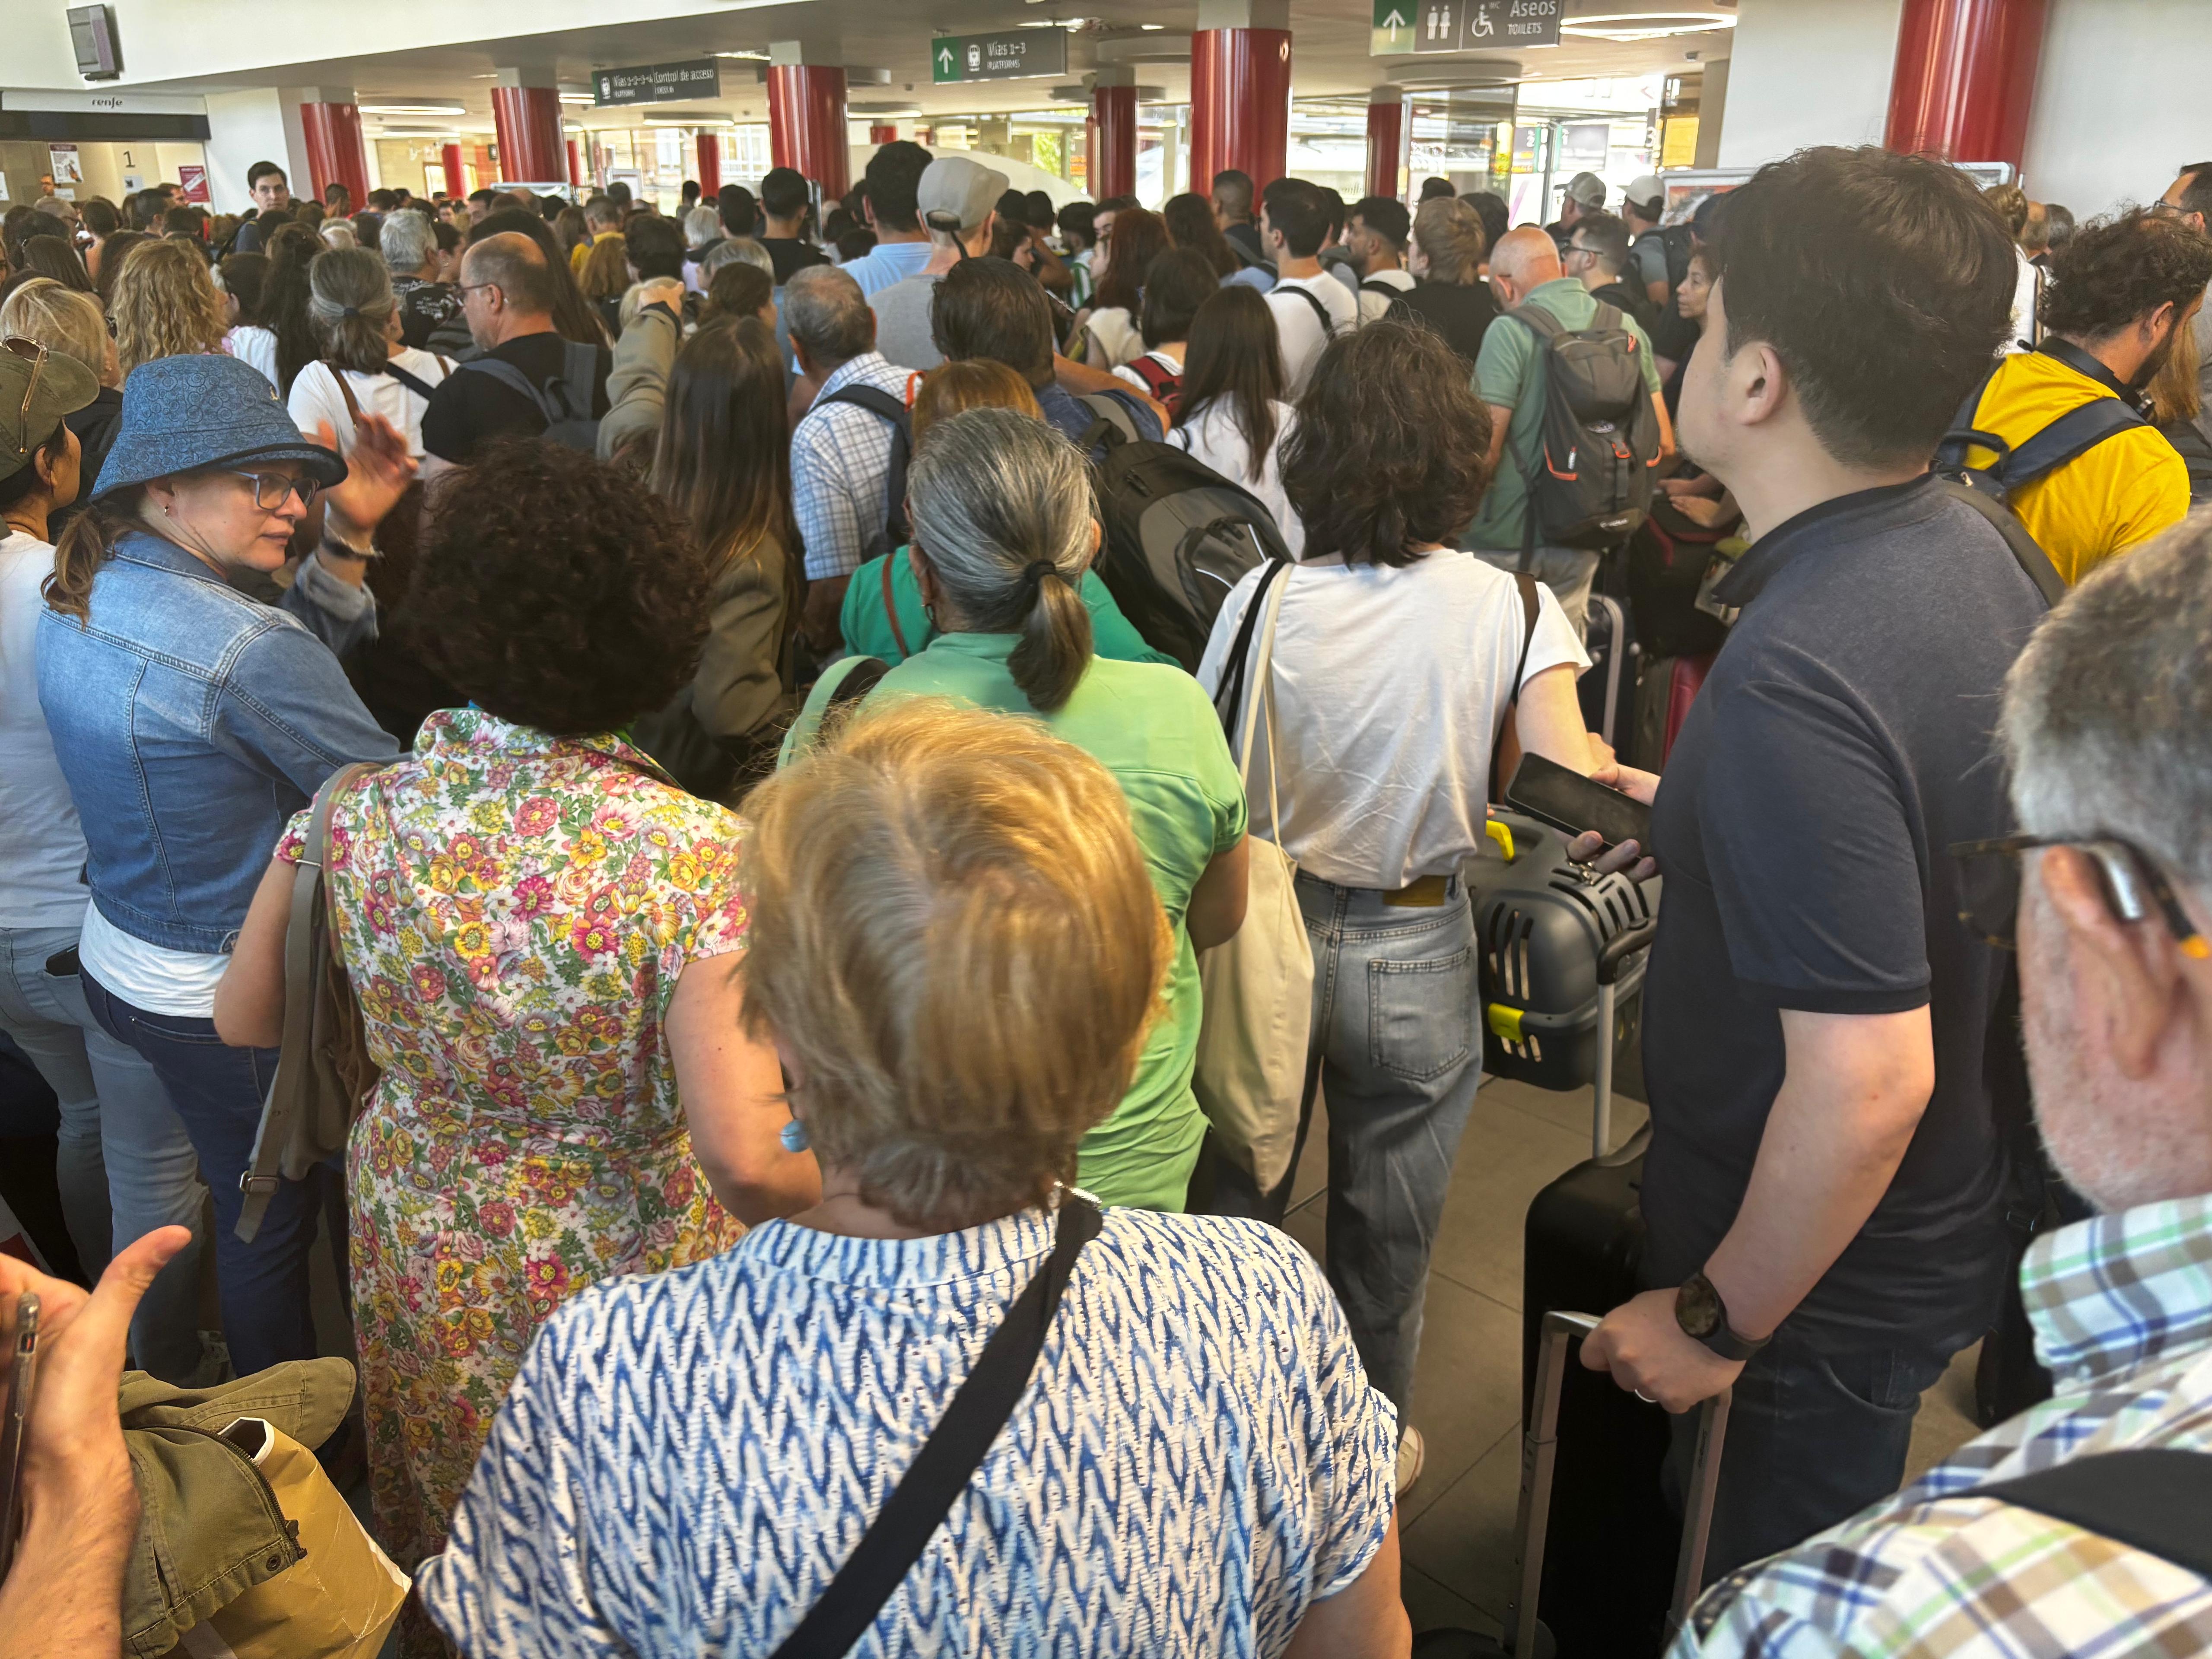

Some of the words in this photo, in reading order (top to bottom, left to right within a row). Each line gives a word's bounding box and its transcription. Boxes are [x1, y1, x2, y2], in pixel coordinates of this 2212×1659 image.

[1510, 0, 1556, 17] Aseos
[1507, 22, 1542, 35] TOILETS
[987, 40, 1007, 57] Vías
[1009, 42, 1026, 55] 1-3
[987, 59, 1020, 70] PLATFORMS
[654, 70, 679, 83] Control
[679, 69, 689, 81] de
[690, 69, 714, 81] acceso
[92, 97, 123, 108] renfe
[124, 150, 136, 167] 1
